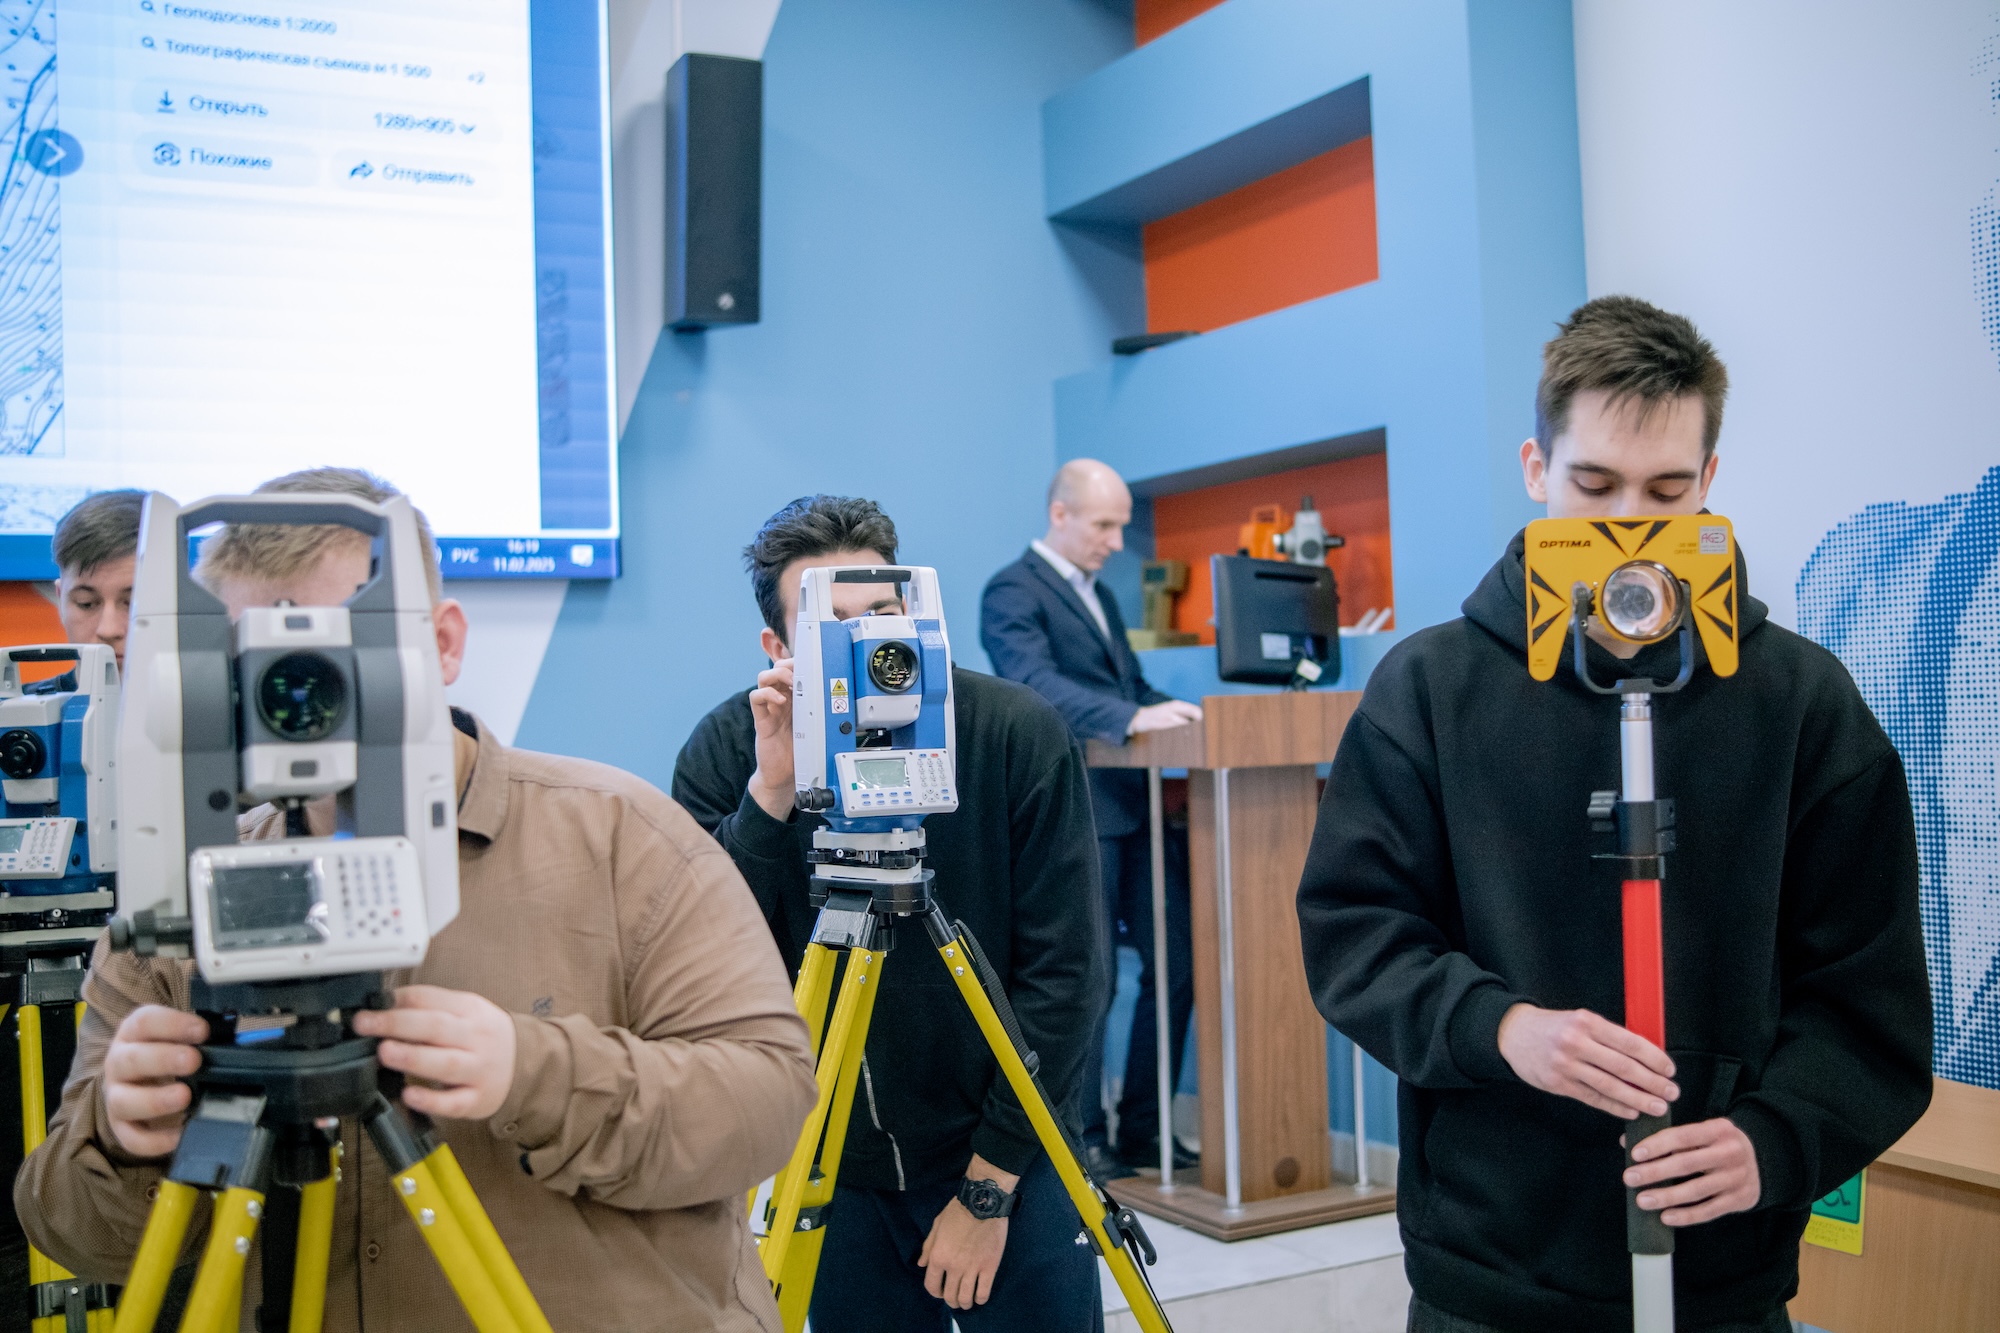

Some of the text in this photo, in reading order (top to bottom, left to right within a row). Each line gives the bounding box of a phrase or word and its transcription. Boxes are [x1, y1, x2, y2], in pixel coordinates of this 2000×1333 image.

[163, 2, 338, 35] Геоподоснова 1:2000
[165, 38, 310, 67] Топографическая
[189, 94, 269, 117] Открыть
[190, 147, 273, 170] Похожие
[382, 163, 475, 187] Отправить
[452, 547, 479, 563] РУС
[1539, 540, 1591, 549] OPTIMA
